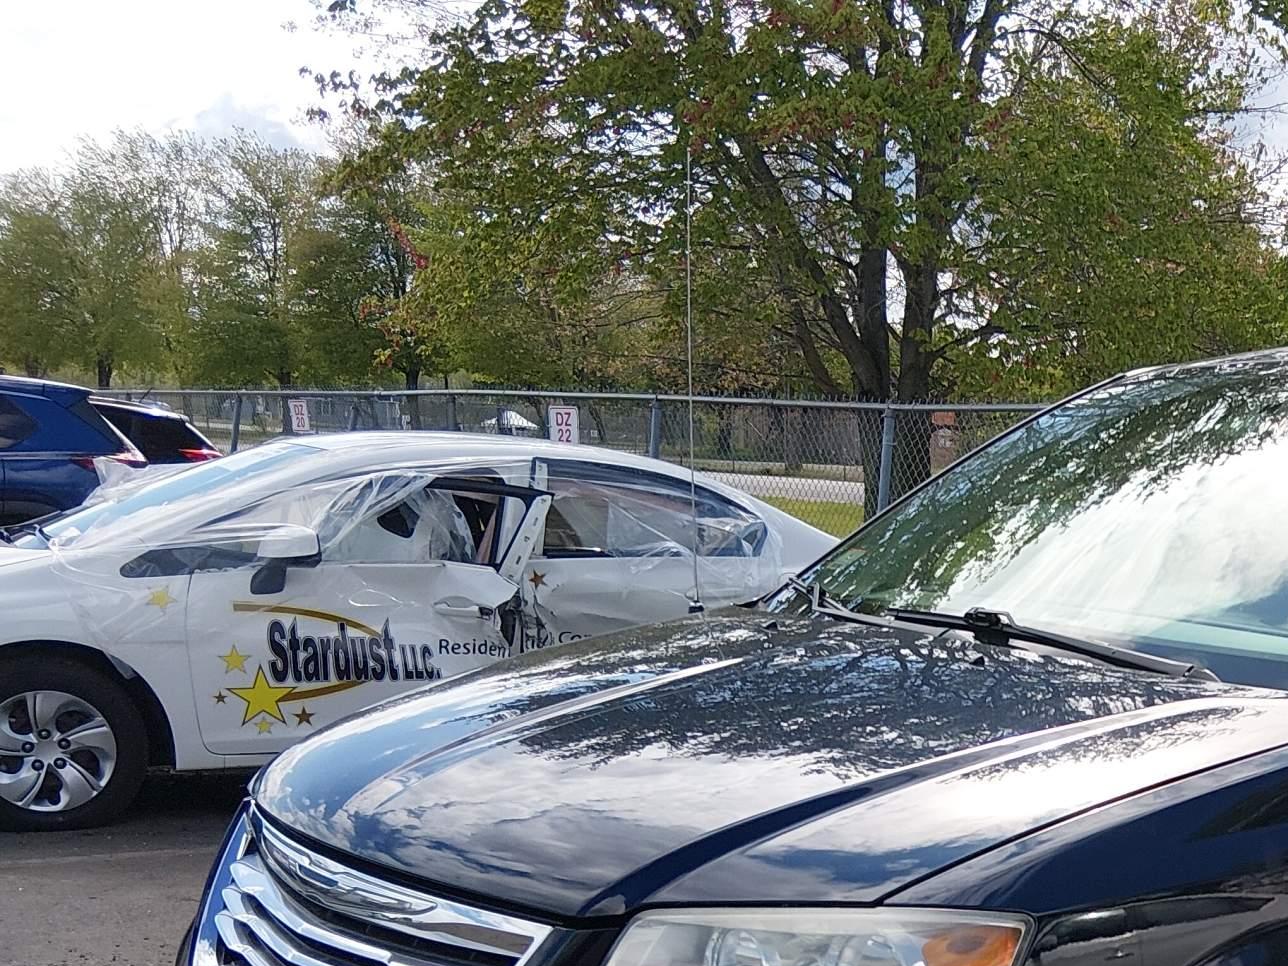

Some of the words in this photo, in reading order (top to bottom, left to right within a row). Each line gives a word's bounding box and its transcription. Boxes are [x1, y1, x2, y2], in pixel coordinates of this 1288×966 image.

[294, 404, 304, 416] DZ
[296, 416, 305, 428] 20
[555, 412, 572, 427] DZ
[557, 428, 572, 443] 22
[267, 616, 399, 682] Stardust
[399, 643, 442, 682] LLC.
